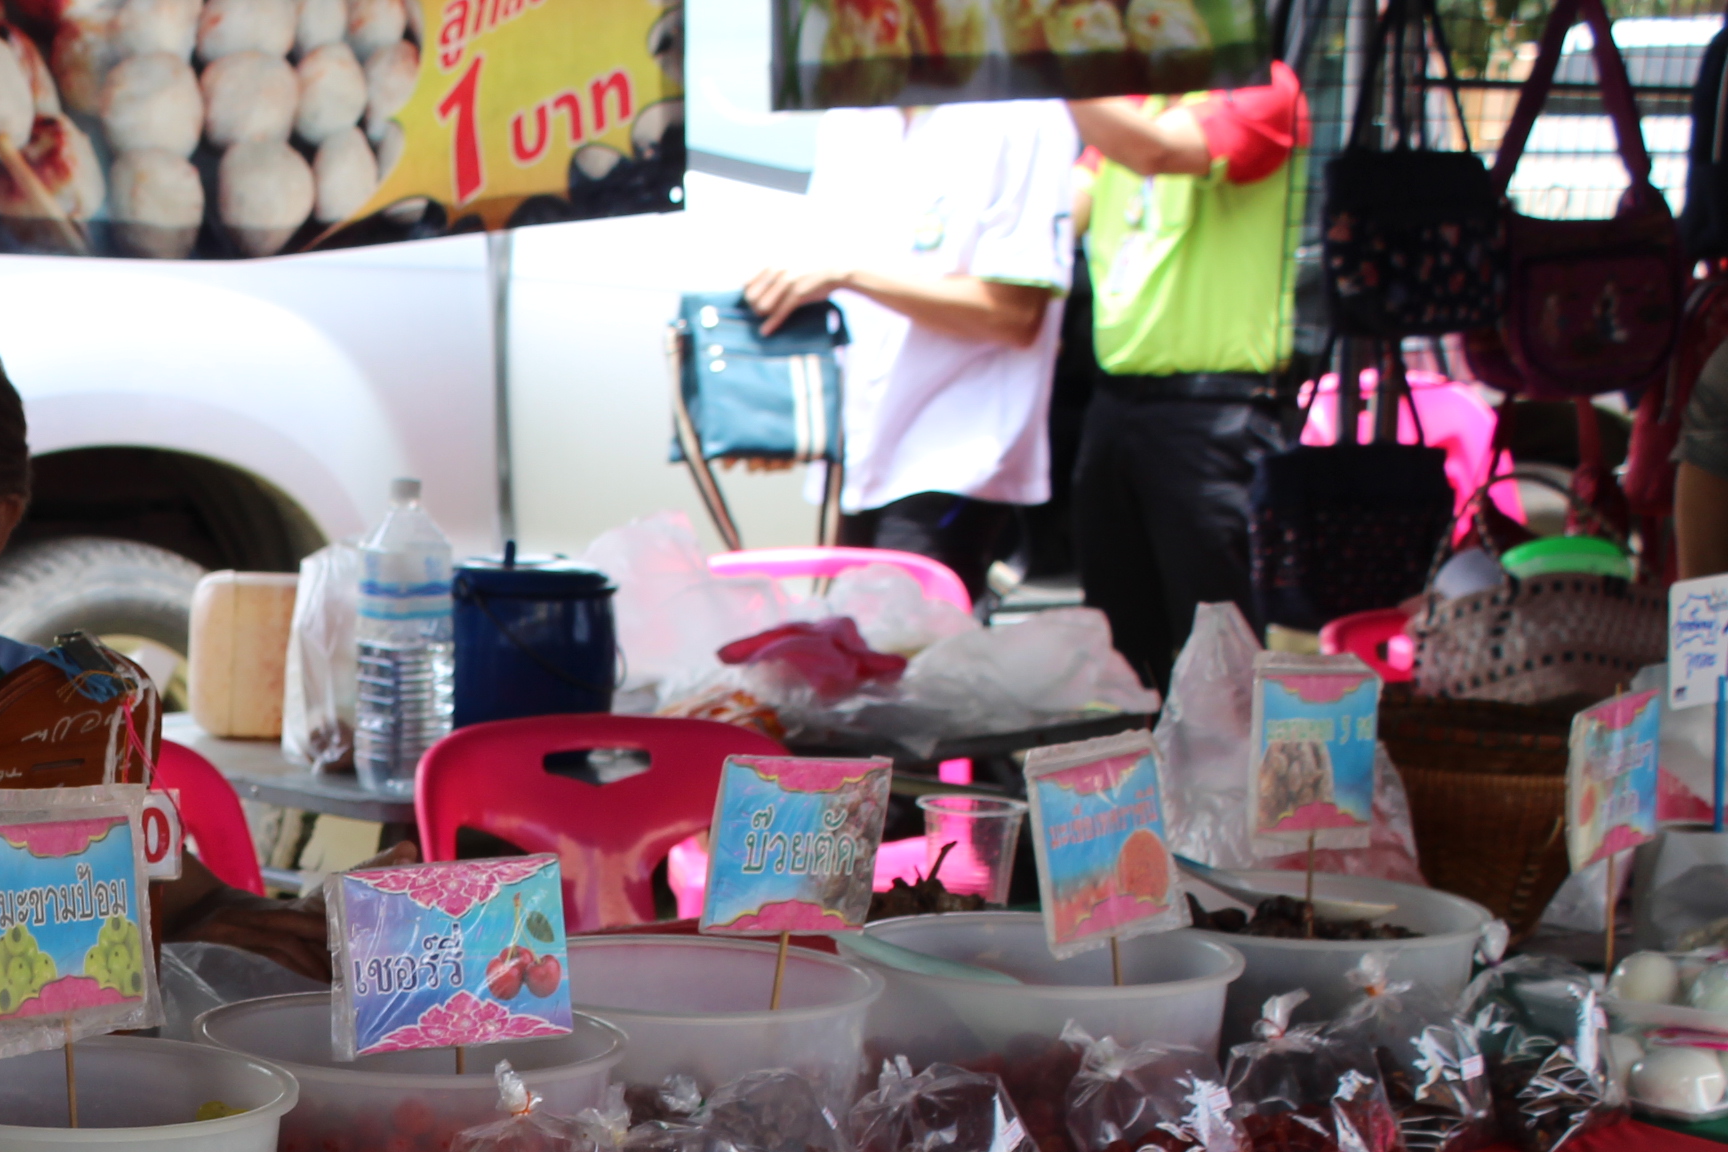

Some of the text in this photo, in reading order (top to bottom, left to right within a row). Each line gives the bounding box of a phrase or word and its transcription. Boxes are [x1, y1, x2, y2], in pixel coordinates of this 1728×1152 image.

[437, 53, 633, 204] 1 บาท
[741, 803, 857, 876] บ๊วยตัด
[354, 922, 464, 995] เชอร์รี่
